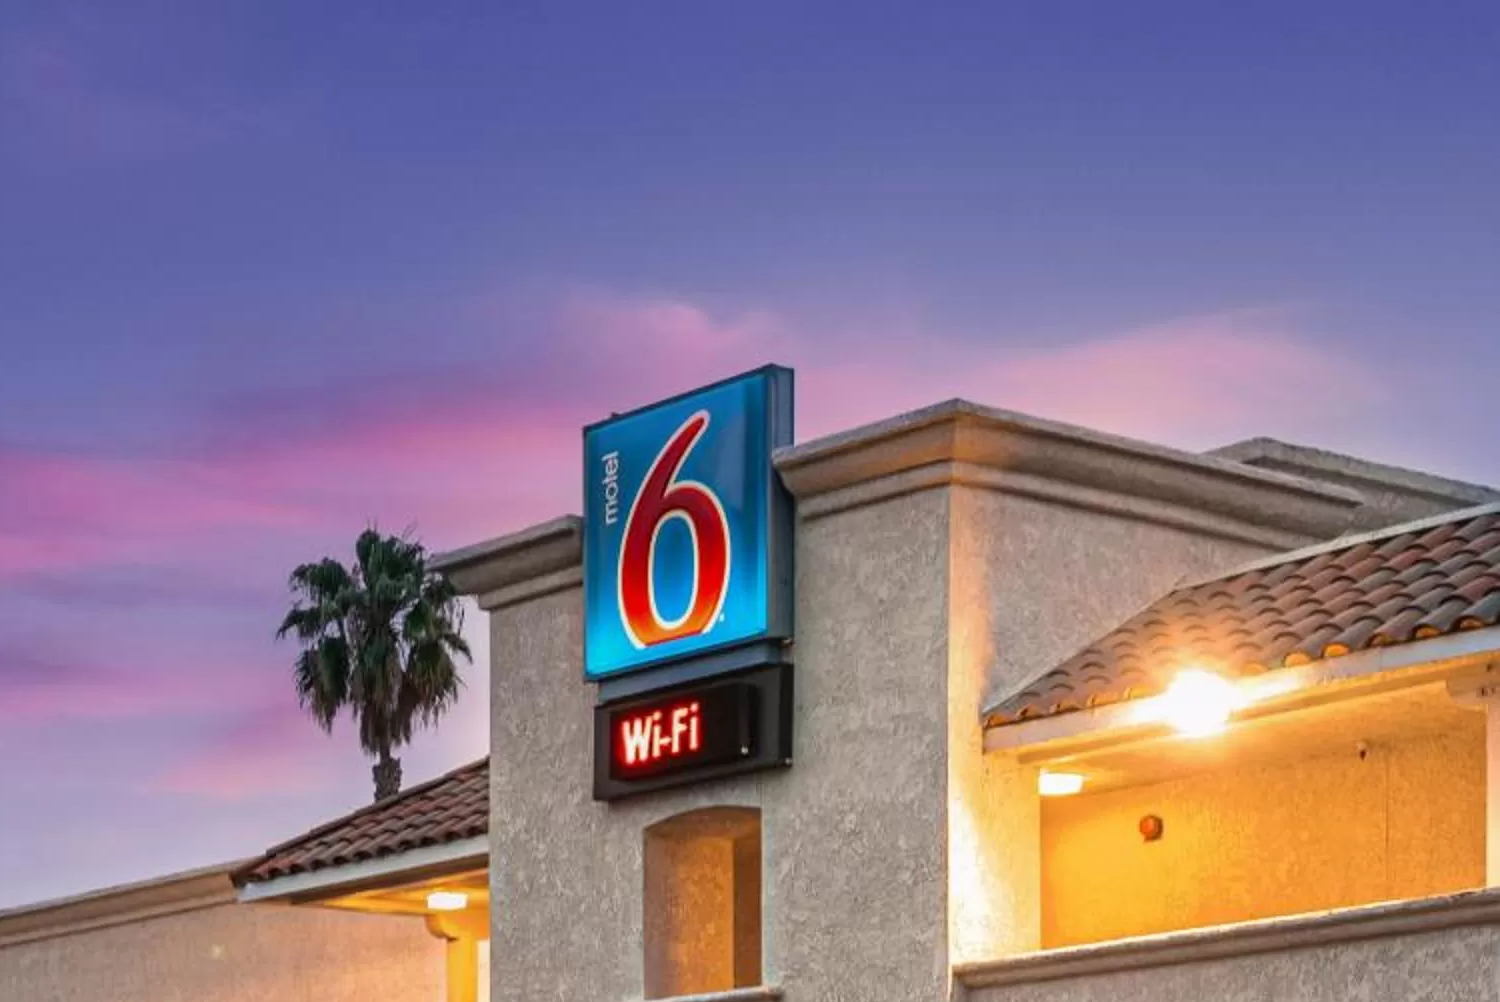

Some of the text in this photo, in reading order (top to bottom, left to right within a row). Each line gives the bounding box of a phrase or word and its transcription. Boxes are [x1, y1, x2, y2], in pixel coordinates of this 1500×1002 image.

[602, 450, 619, 525] motel
[617, 409, 731, 650] 6
[622, 702, 699, 765] Wi-Fi
